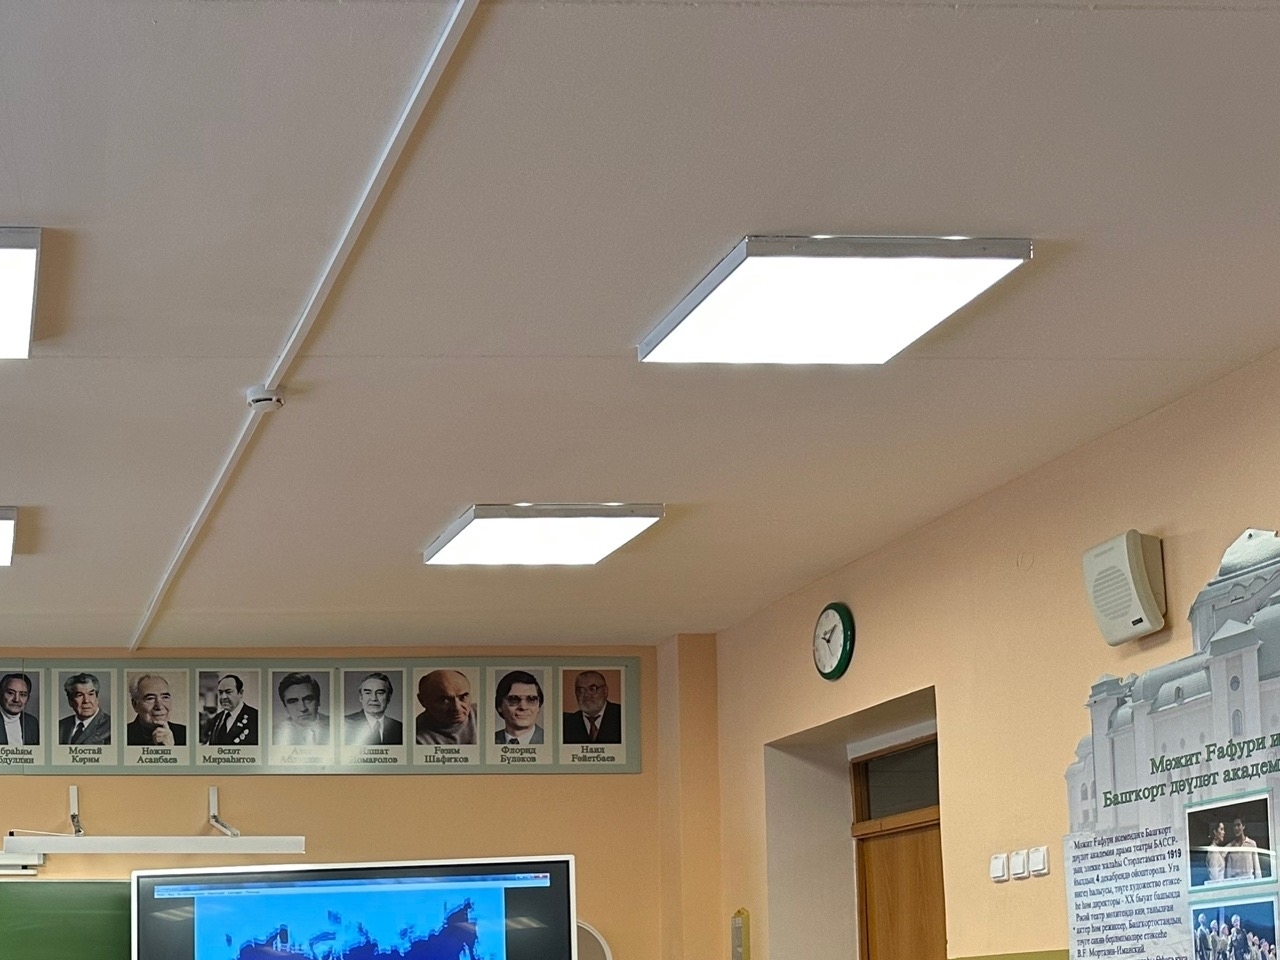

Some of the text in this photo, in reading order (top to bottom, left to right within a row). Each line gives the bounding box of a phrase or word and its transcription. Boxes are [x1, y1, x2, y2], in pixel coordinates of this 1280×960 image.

[69, 746, 102, 754] Мостай
[71, 755, 100, 764] Кәрим
[137, 755, 178, 764] Асанбаев
[202, 755, 256, 764] Мирзаһитов
[1150, 751, 1201, 775] Мәжит
[1205, 738, 1266, 762] Ғафури
[1102, 783, 1167, 808] Башҡорт
[1170, 772, 1219, 797] дәүләт
[1116, 847, 1132, 856] драма
[1134, 842, 1153, 852] театры
[1154, 837, 1178, 848] БАССР-
[1167, 849, 1182, 859] 1919
[1096, 875, 1100, 883] 4
[1129, 880, 1161, 893] художество
[1092, 898, 1120, 910] директоры
[1136, 894, 1153, 903] быуат
[1154, 890, 1180, 900] башында
[1091, 912, 1105, 921] театр
[1076, 925, 1090, 935] актер
